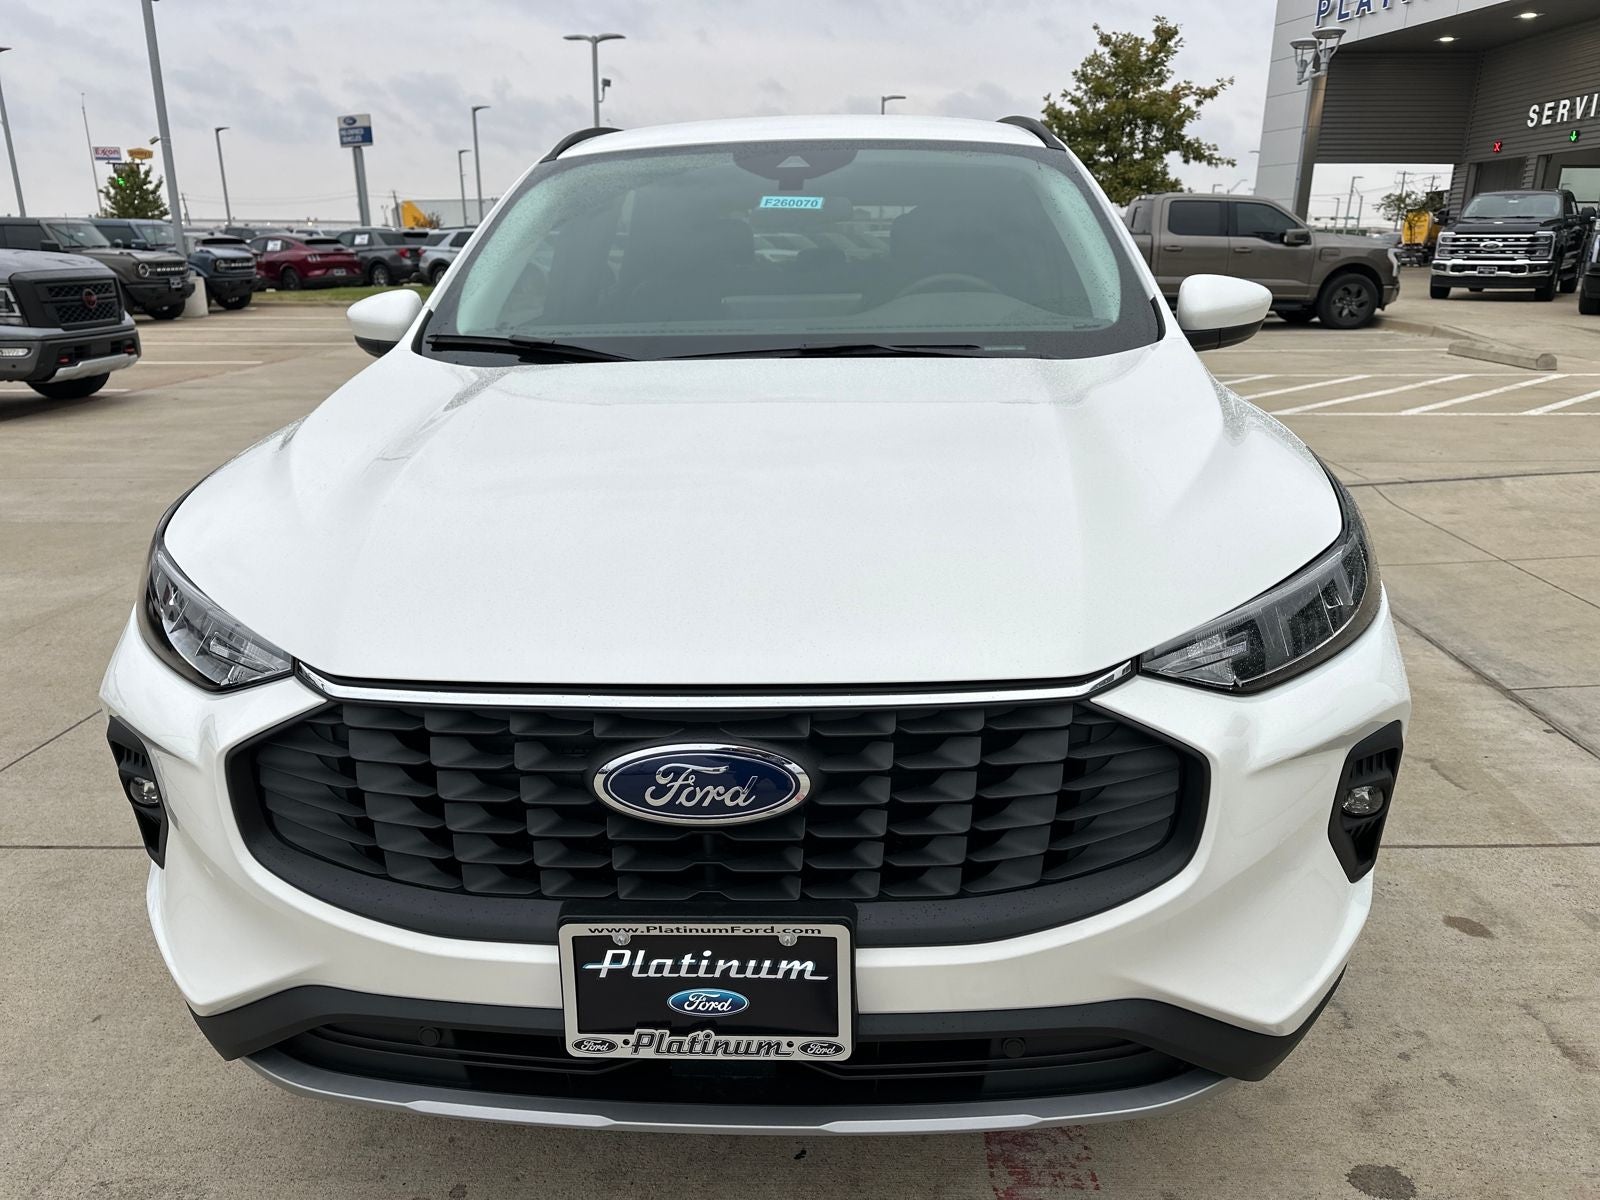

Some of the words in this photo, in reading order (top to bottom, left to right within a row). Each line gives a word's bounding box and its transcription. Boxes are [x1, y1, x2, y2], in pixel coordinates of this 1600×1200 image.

[1527, 93, 1599, 128] SERVI
[764, 198, 819, 208] F260070
[645, 763, 758, 807] Ford
[588, 926, 822, 935] www.PlatinumFord.com
[583, 949, 829, 980] Platinum
[684, 992, 732, 1011] Ford
[580, 1039, 609, 1051] Ford
[627, 1030, 794, 1057] Platinum
[807, 1043, 836, 1054] Ford
